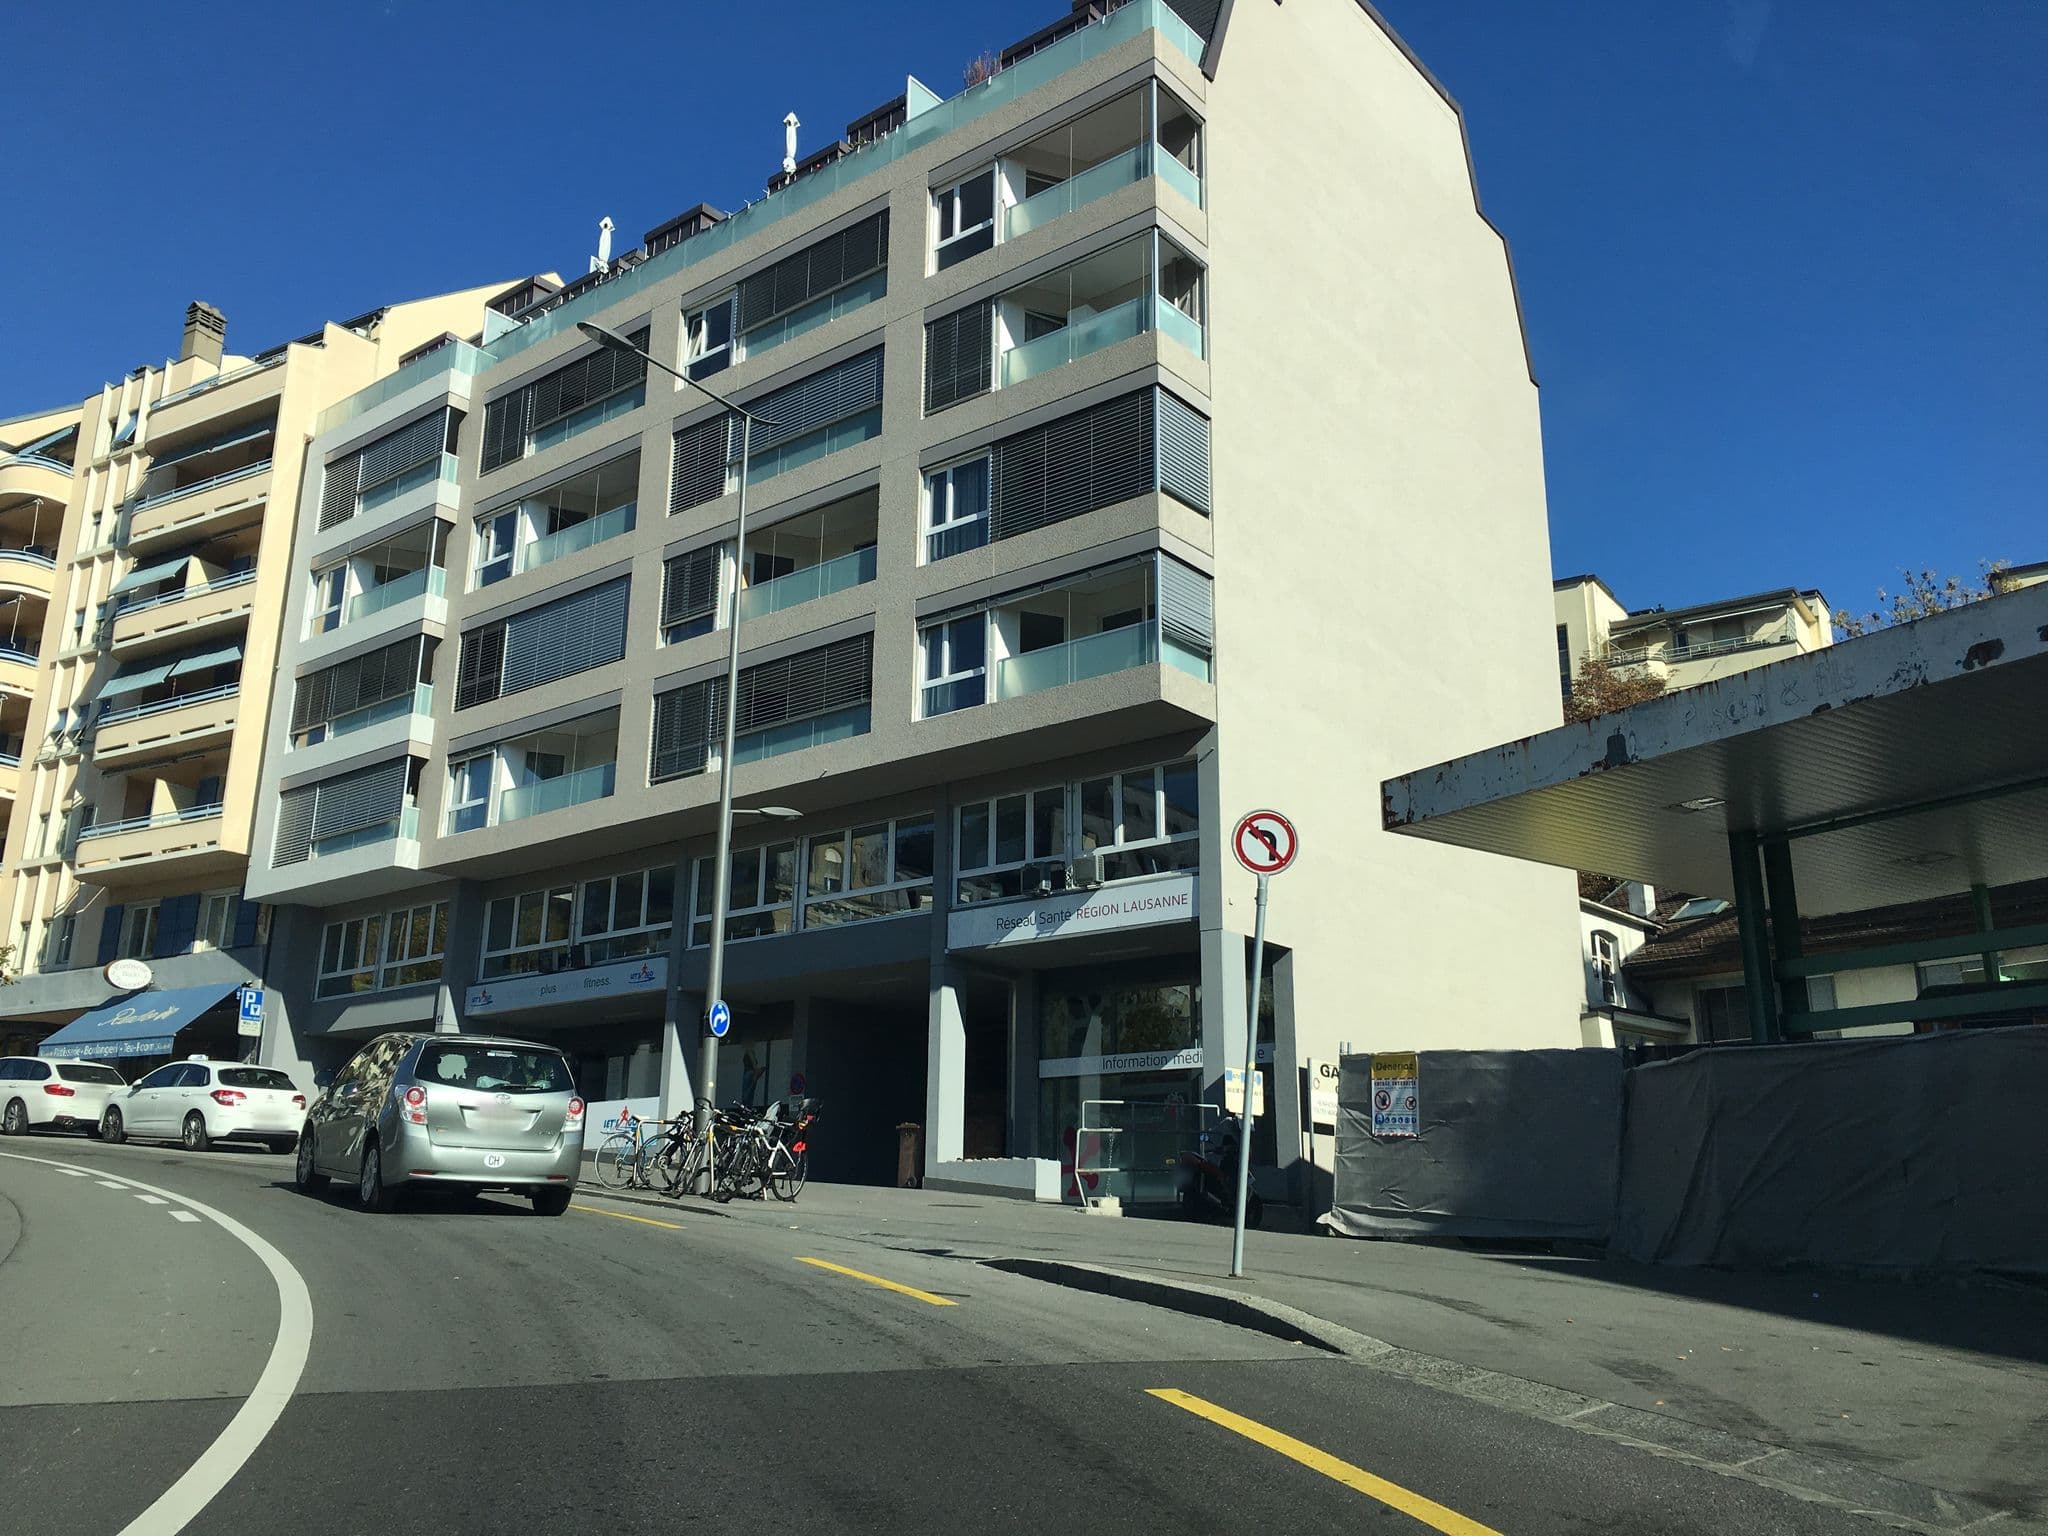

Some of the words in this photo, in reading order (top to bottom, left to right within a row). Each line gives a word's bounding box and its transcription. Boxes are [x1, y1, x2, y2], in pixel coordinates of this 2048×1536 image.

[996, 911, 1037, 930] Réseau
[1039, 907, 1072, 925] Santé
[1123, 893, 1188, 913] LAUSANNE
[540, 983, 557, 997] plus
[244, 991, 256, 1009] P
[1102, 1055, 1168, 1070] Information
[1320, 1063, 1339, 1079] GA
[487, 1155, 500, 1166] CH
